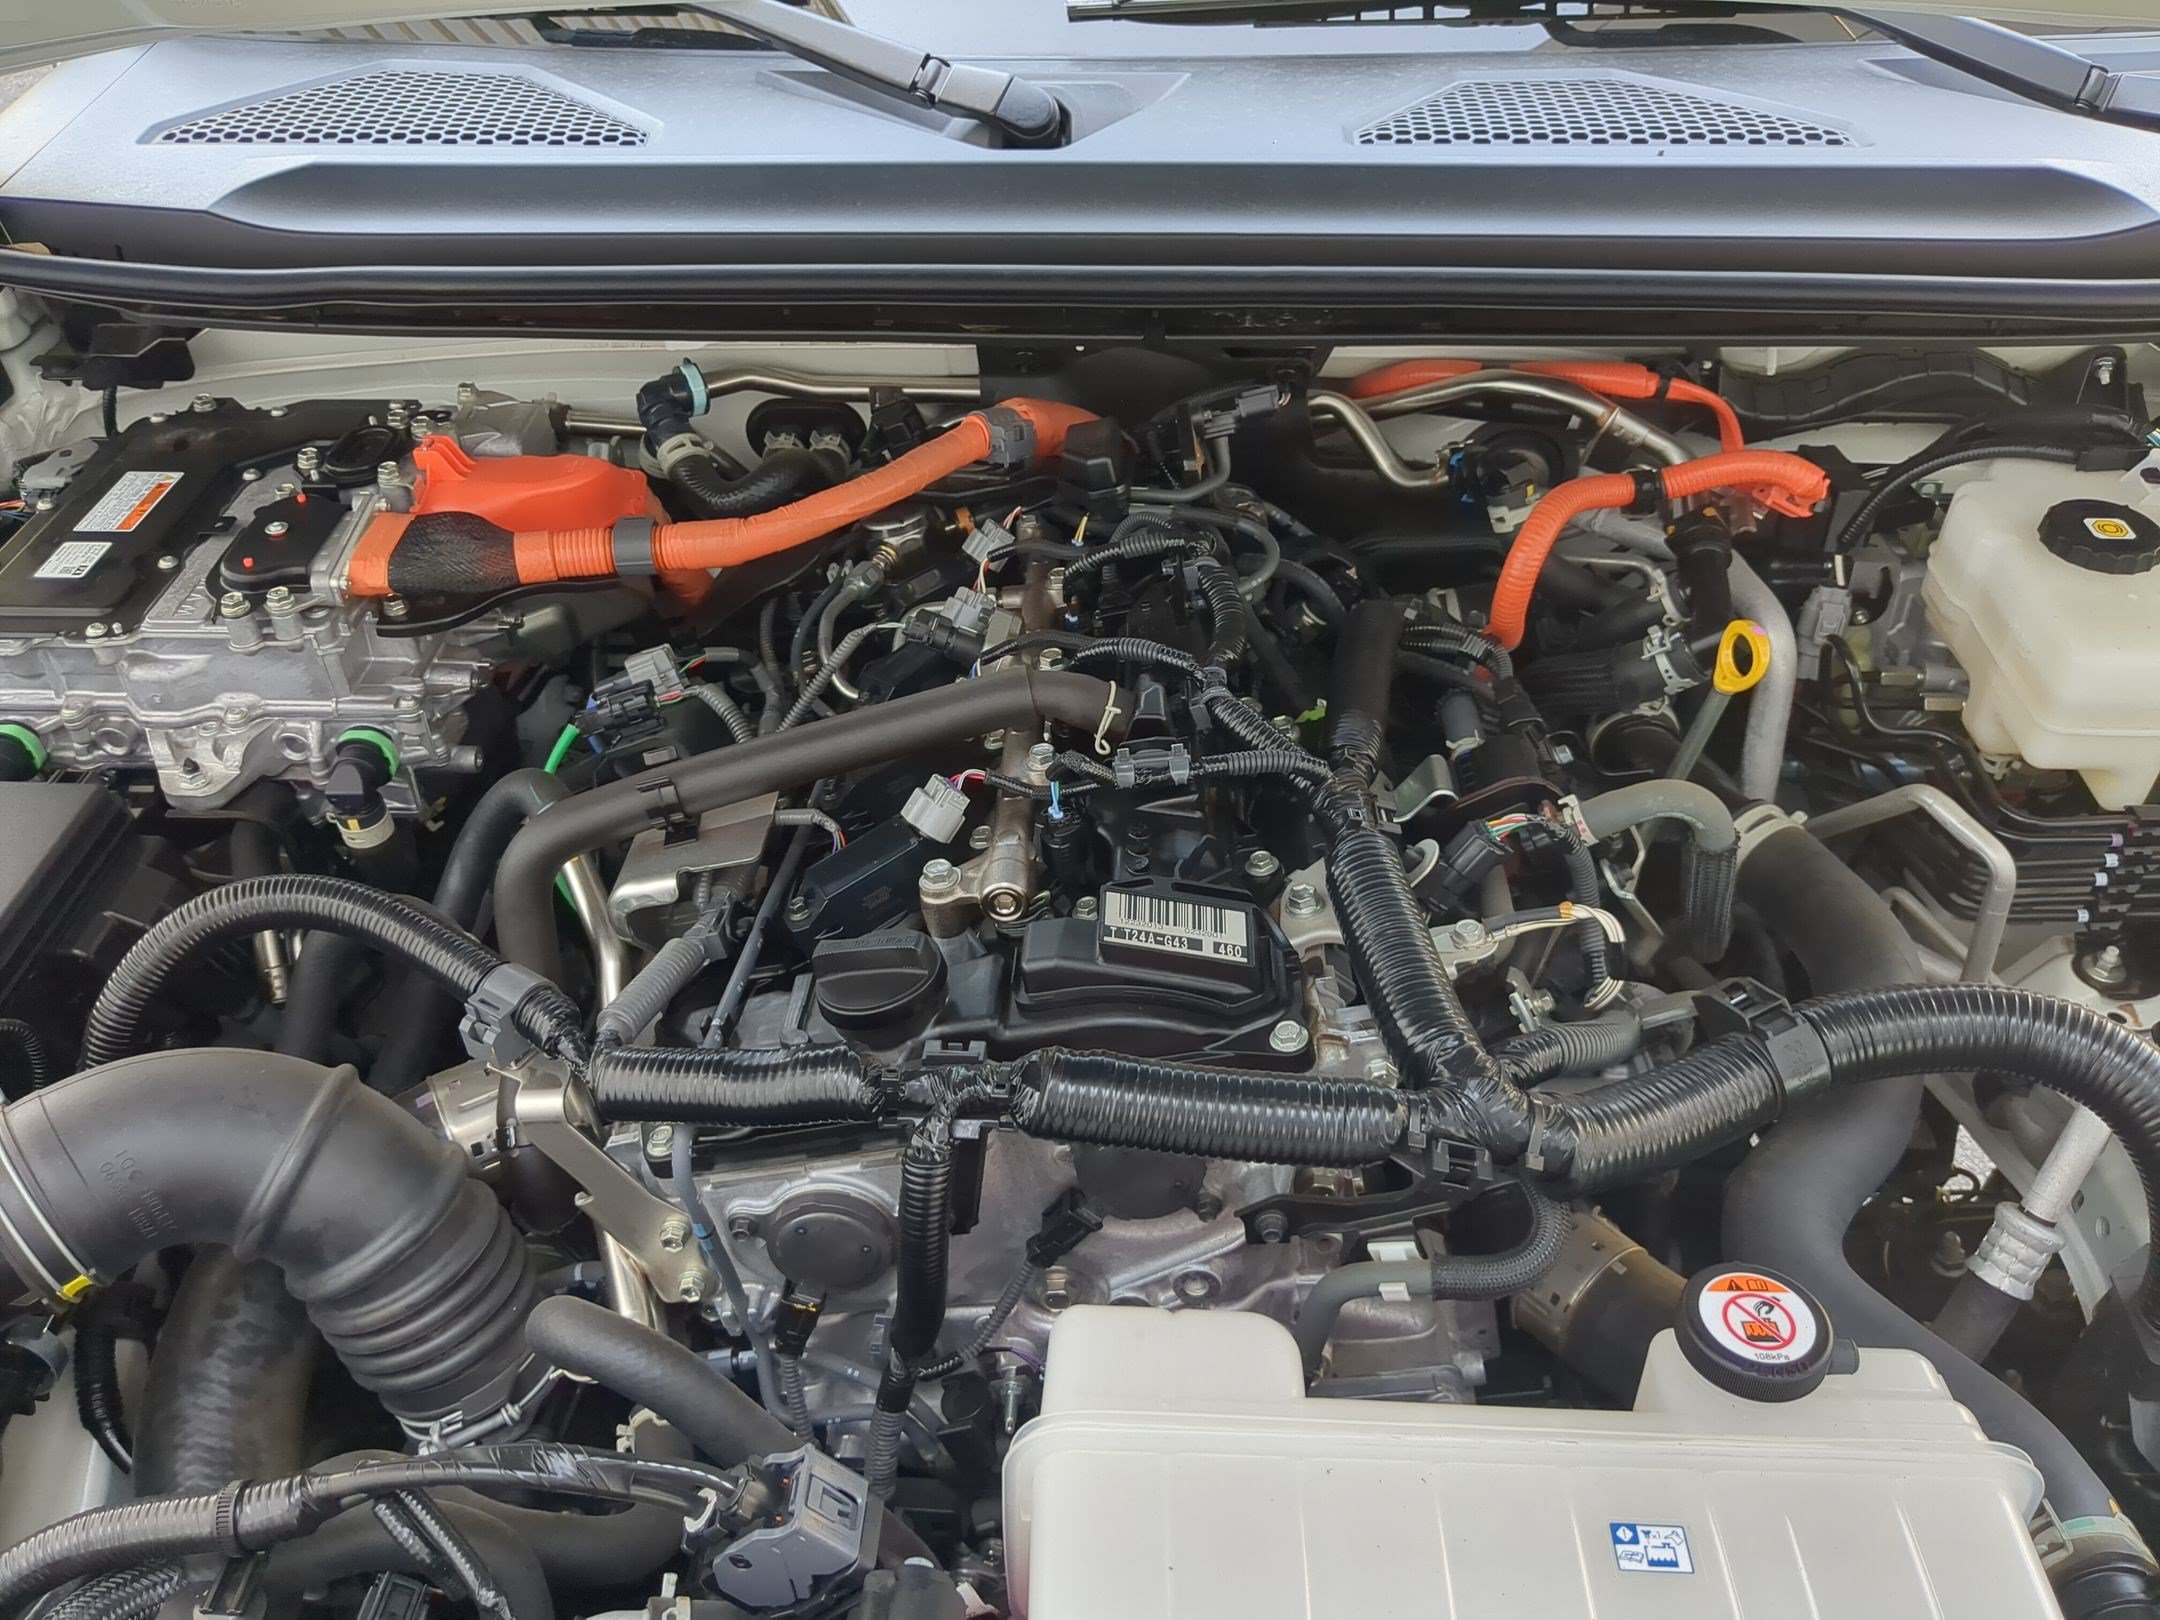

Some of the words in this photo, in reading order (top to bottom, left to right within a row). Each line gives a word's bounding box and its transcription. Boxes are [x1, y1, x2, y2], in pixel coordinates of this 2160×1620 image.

[1110, 927, 1117, 938] T
[1124, 928, 1188, 949] T24A-G43
[1218, 943, 1242, 957] 460
[1754, 1352, 1791, 1361] 108kPa
